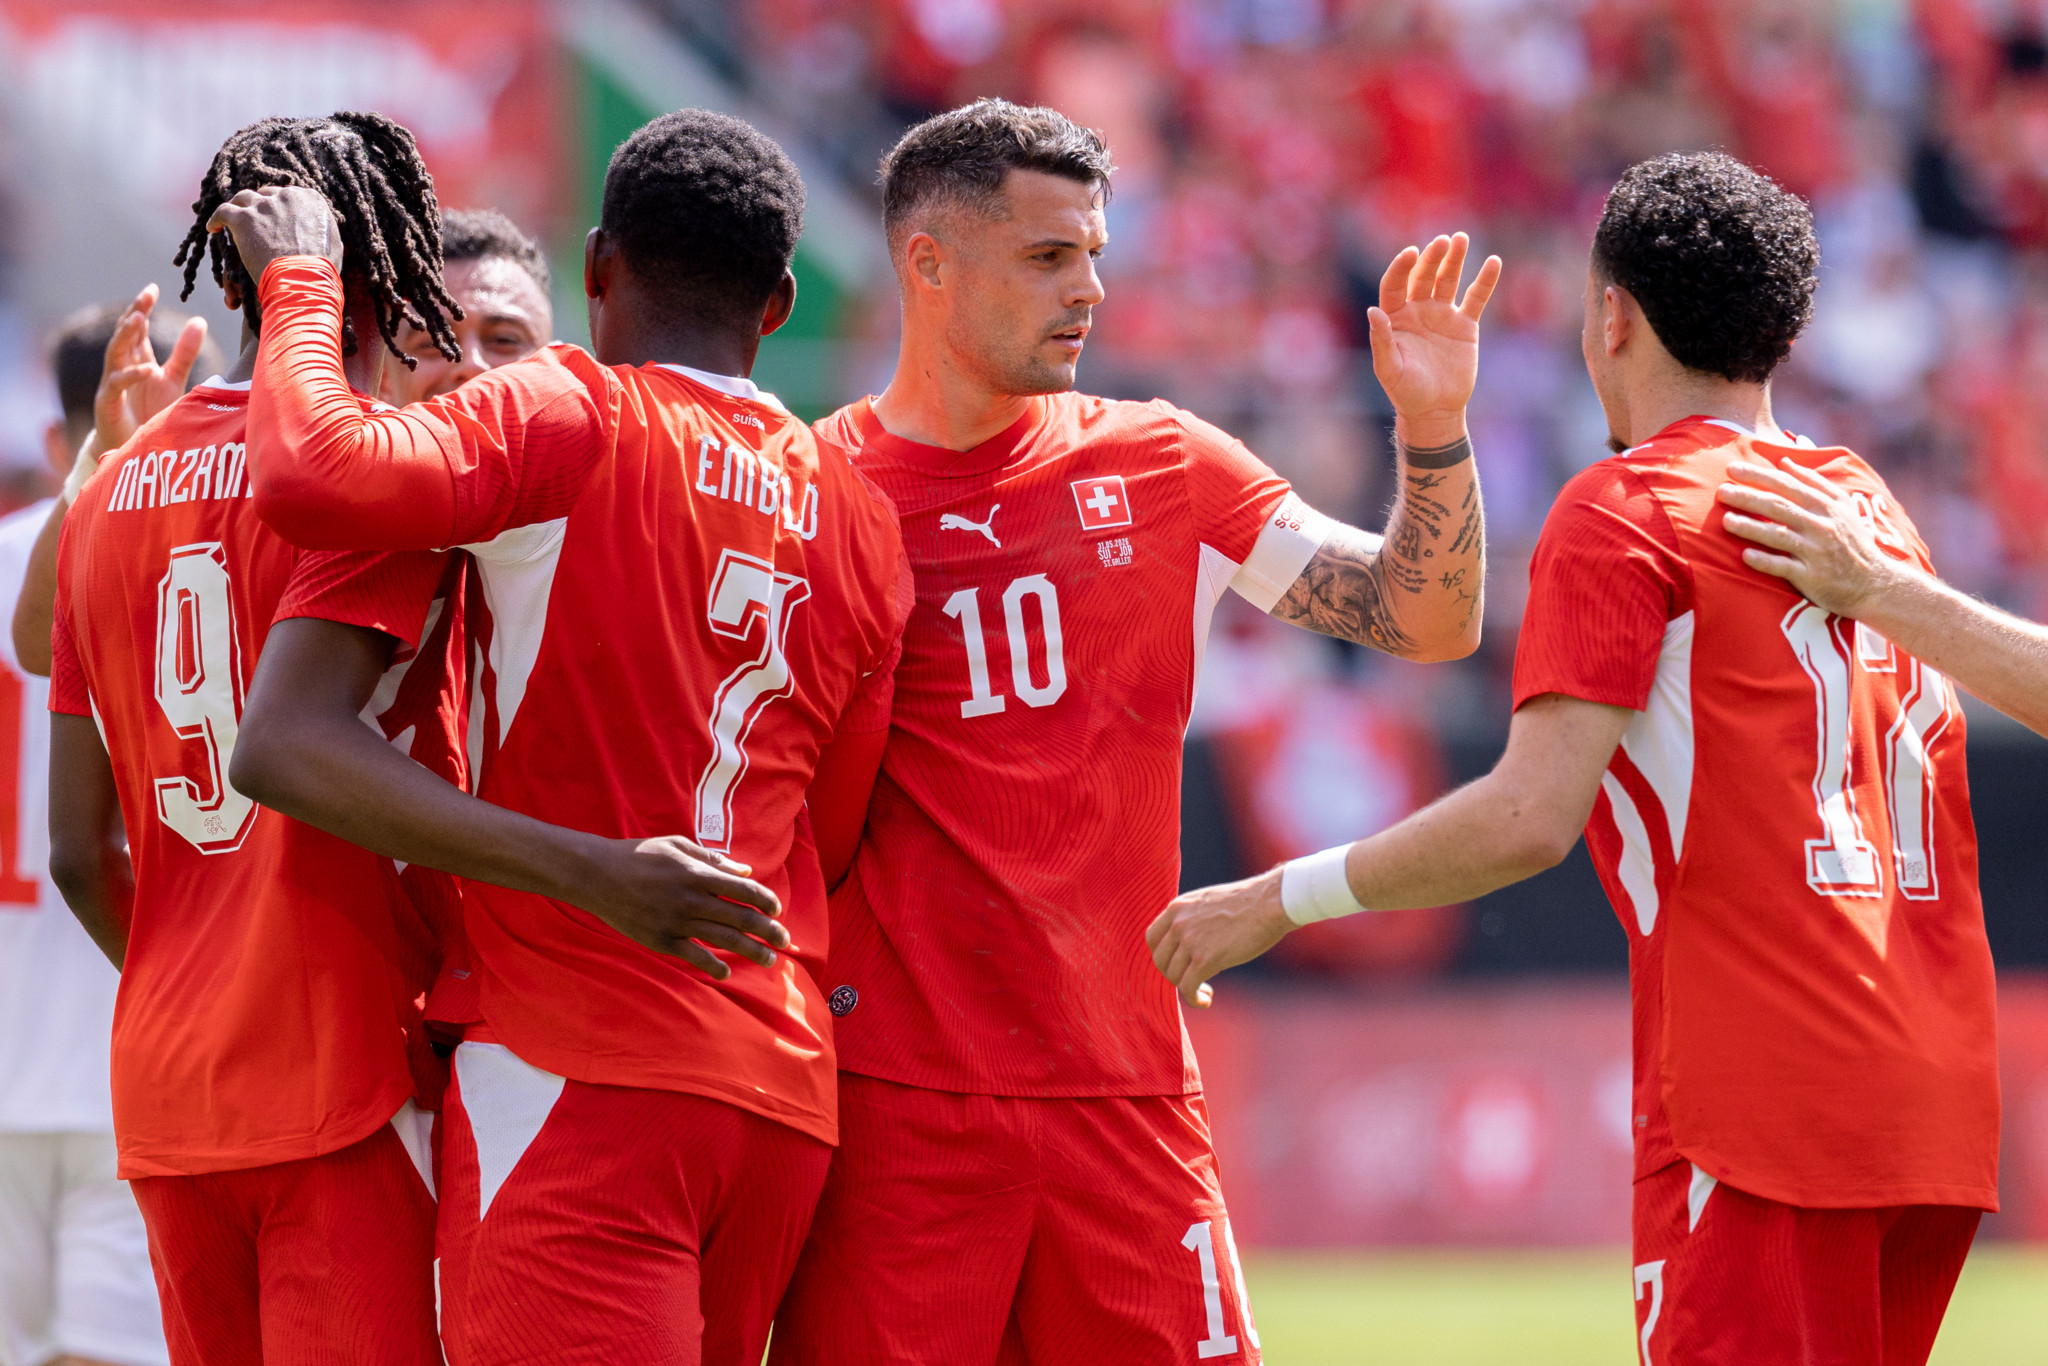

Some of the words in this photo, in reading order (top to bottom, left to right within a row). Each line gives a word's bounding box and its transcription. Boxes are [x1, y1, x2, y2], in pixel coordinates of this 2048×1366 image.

[107, 441, 253, 512] MANZAM
[1097, 548, 1112, 561] SUI
[154, 541, 260, 855] 9
[696, 548, 811, 854] 7
[942, 572, 1067, 719] 10
[1780, 599, 1952, 900] 17
